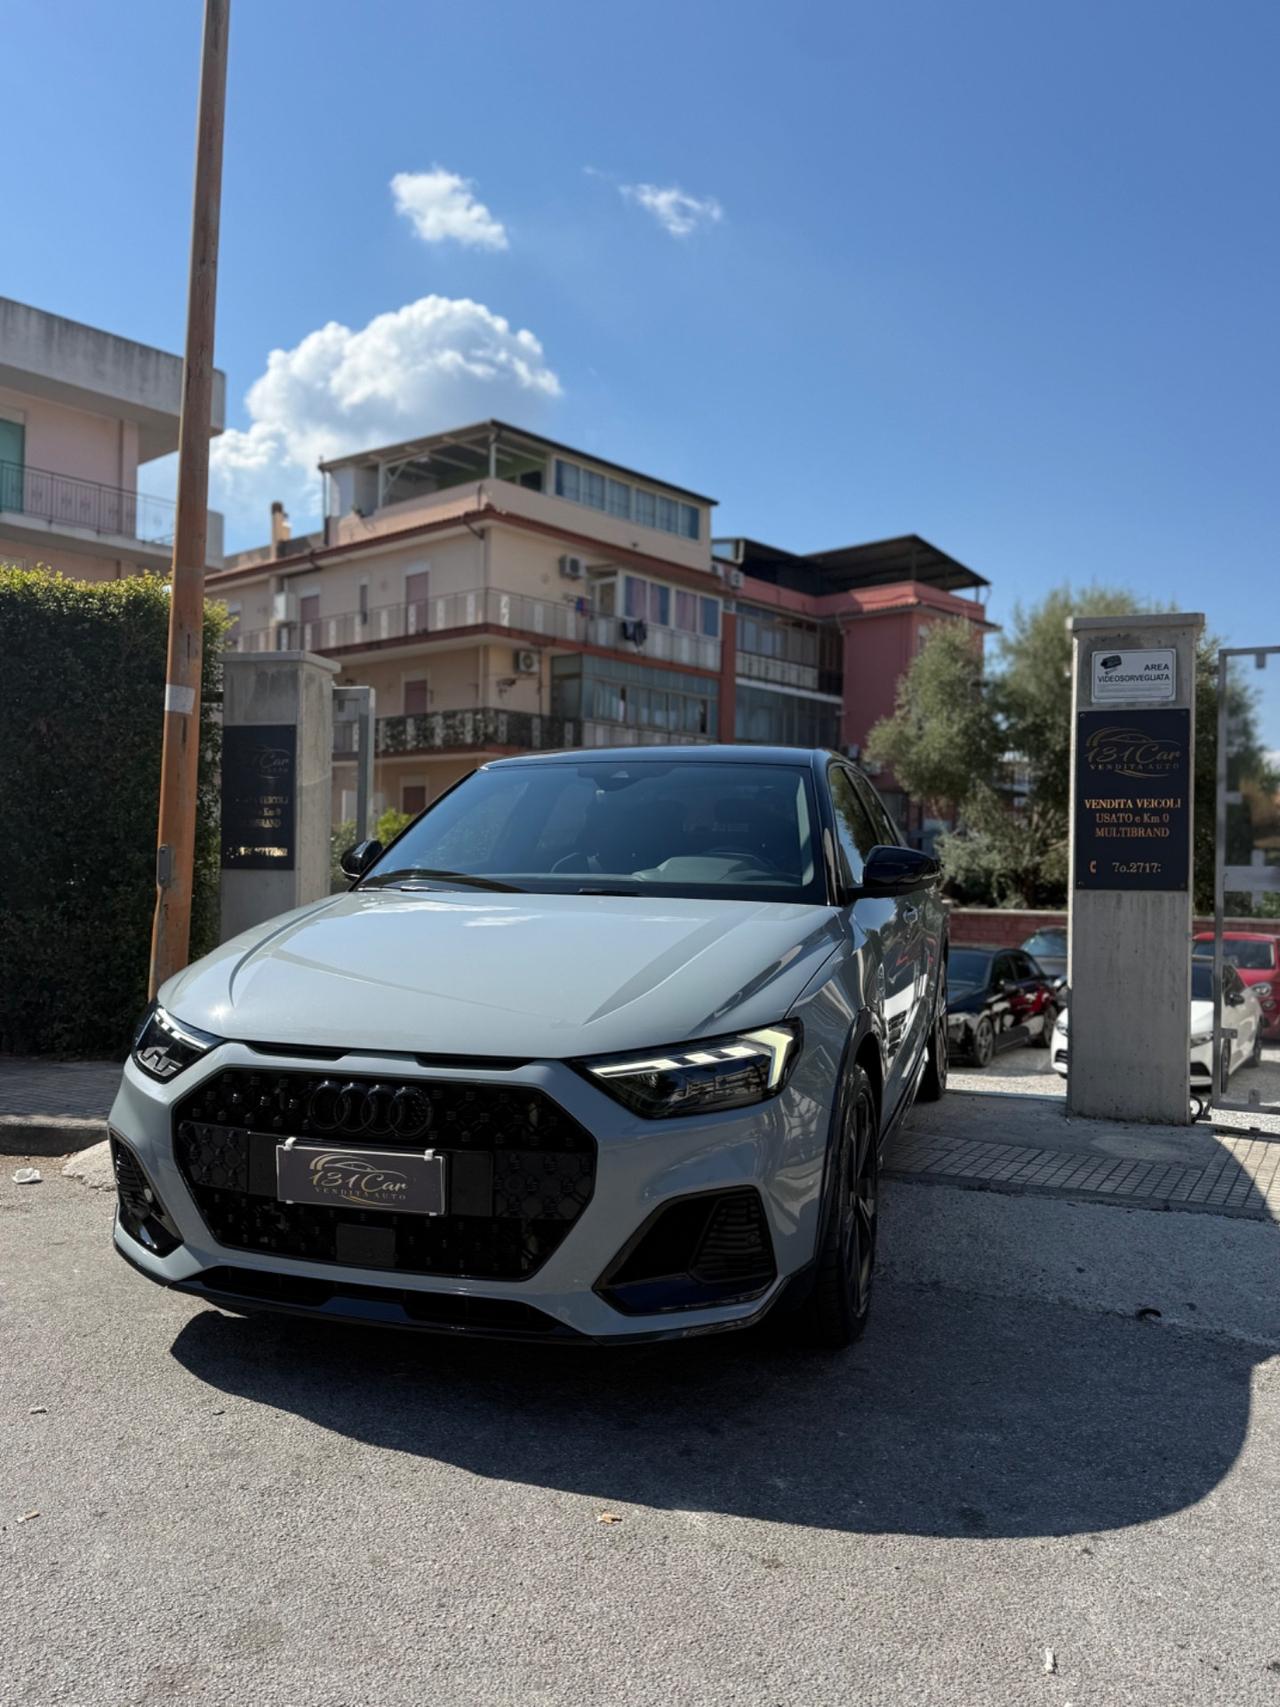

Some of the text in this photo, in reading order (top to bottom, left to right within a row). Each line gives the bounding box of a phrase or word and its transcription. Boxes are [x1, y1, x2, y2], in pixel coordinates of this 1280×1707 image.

[1144, 663, 1170, 671] AREA
[1097, 673, 1170, 682] VIDEOSORVEGLIATA
[1085, 798, 1180, 809] VENDITA VEICOLI
[1095, 813, 1132, 823] USATO
[1143, 812, 1160, 823] Km
[1095, 827, 1170, 838] MULTIBRAND
